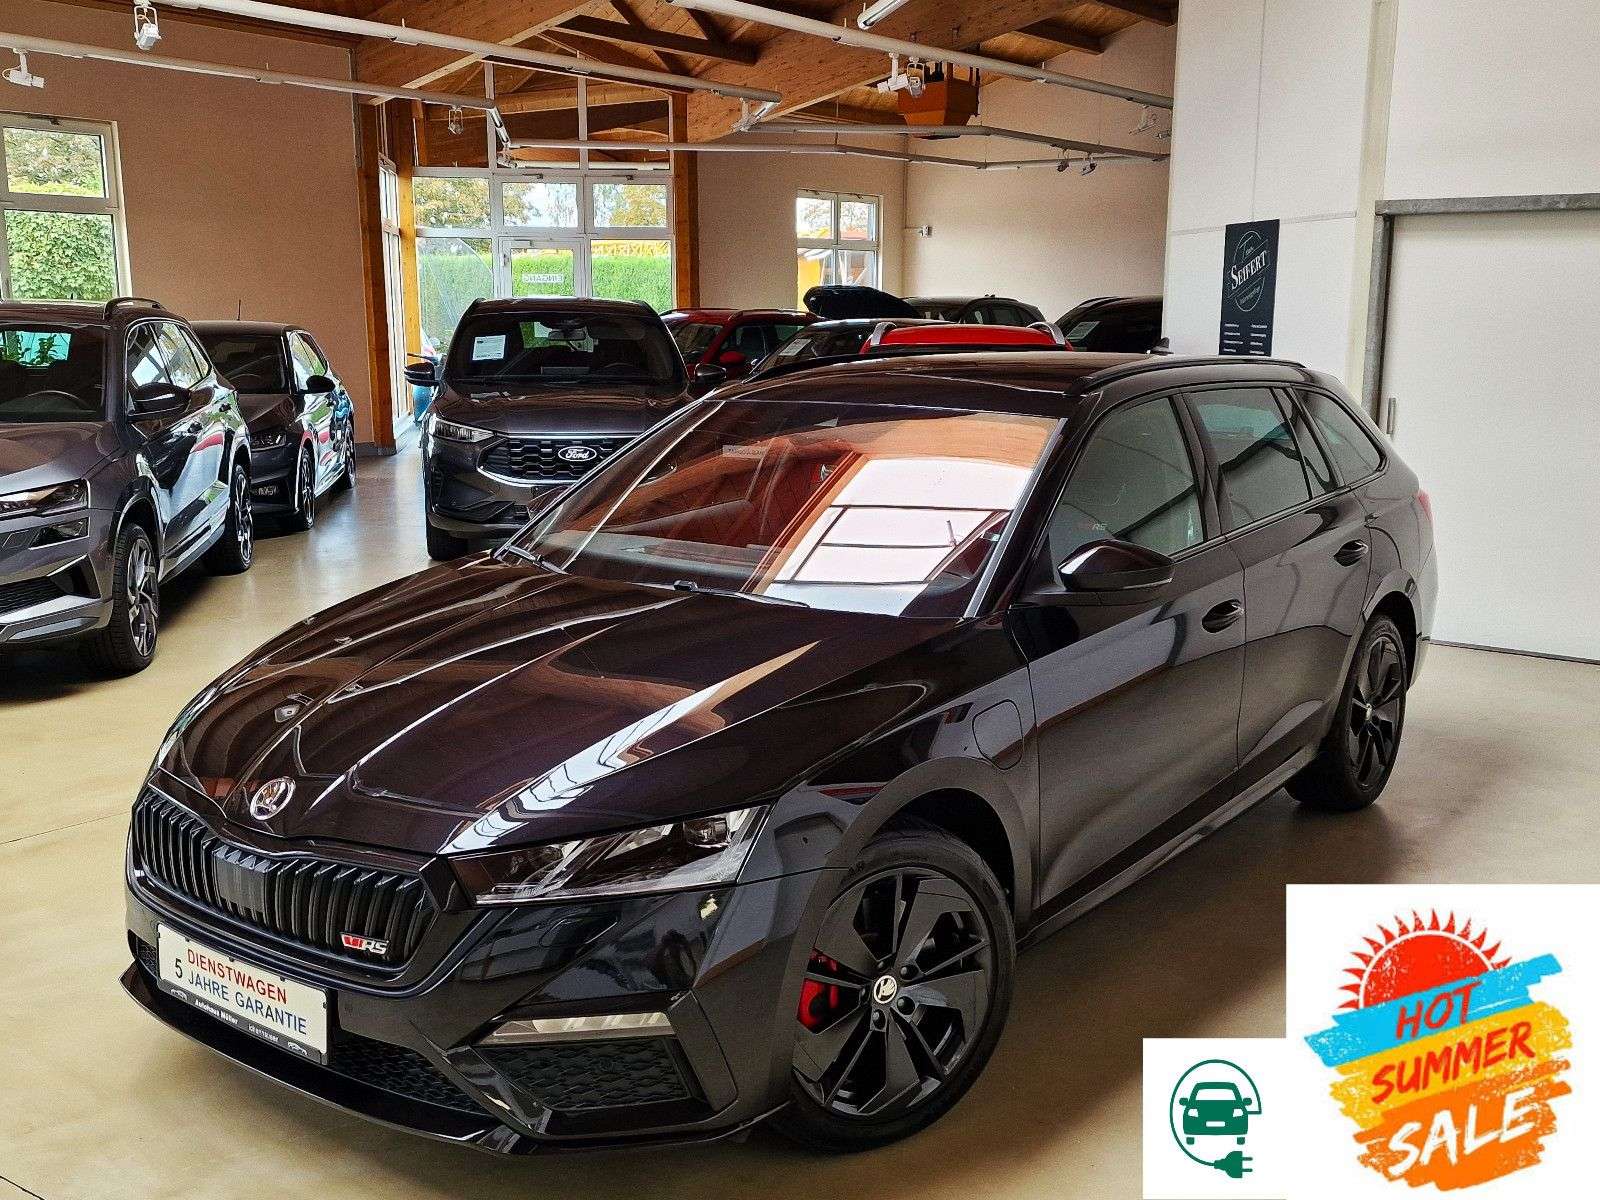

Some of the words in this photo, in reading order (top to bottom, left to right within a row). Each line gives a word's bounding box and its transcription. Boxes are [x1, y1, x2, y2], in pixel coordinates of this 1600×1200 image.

[565, 448, 590, 460] Ford
[174, 957, 184, 979] 5
[188, 970, 230, 1002] JAHRE
[235, 991, 308, 1035] GARANTIE
[187, 948, 288, 1005] DIENSTWAGEN
